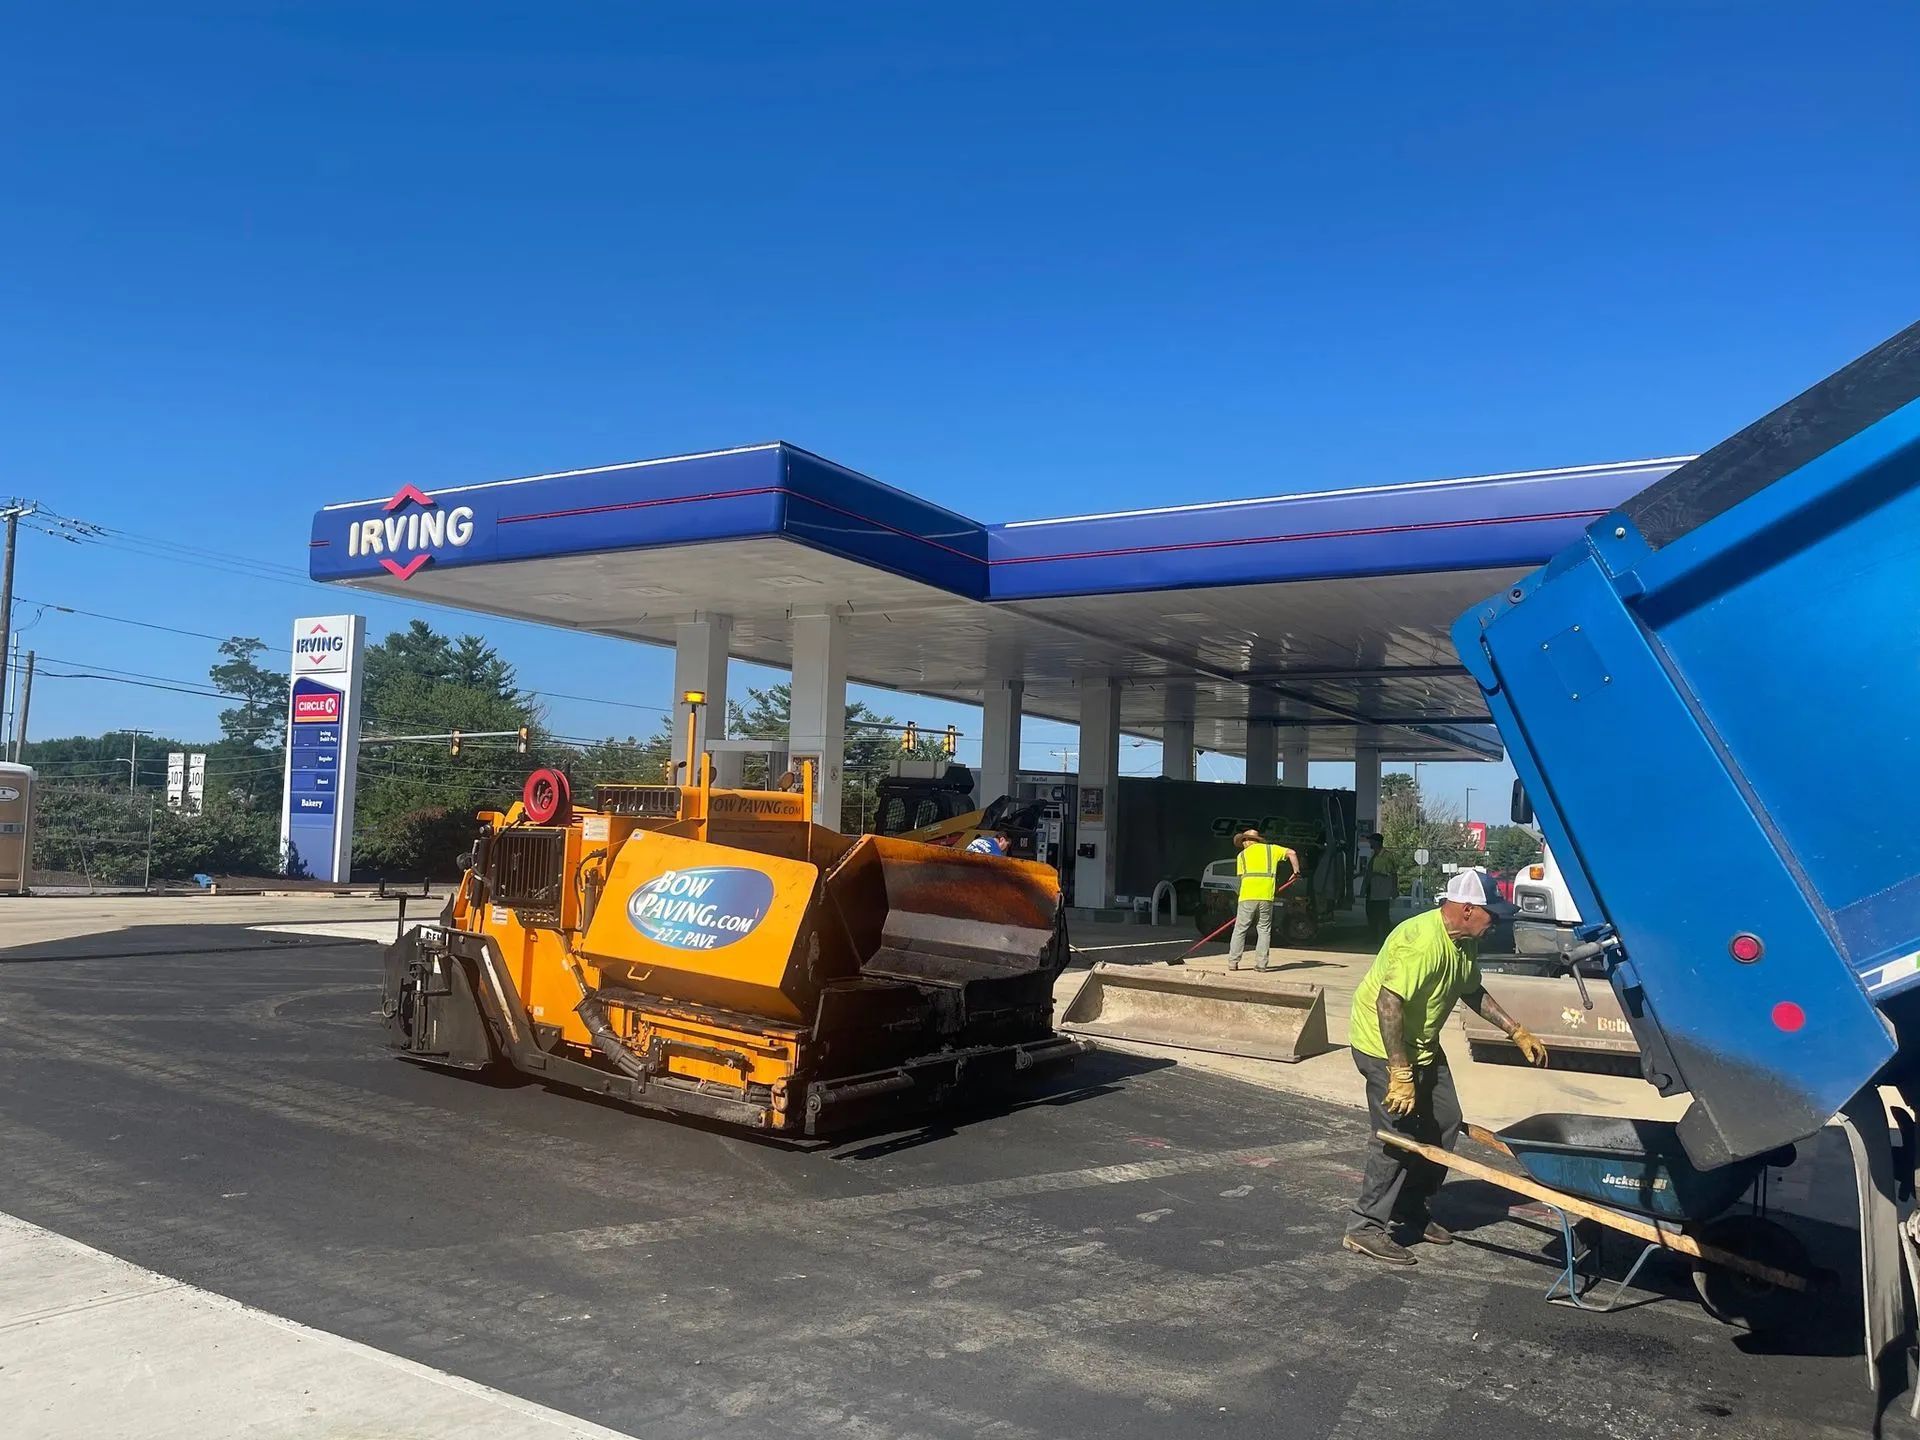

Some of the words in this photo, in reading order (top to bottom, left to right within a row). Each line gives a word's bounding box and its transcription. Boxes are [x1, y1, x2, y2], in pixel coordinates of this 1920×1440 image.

[349, 506, 474, 557] IRVING
[296, 636, 343, 654] IRVING
[298, 701, 324, 711] CIRCLE
[326, 698, 335, 712] K
[194, 756, 201, 764] TO
[171, 771, 182, 785] 107
[192, 772, 203, 786] 101
[301, 798, 323, 809] Bakery
[709, 798, 736, 812] OW
[655, 870, 714, 899] BOW
[635, 893, 755, 934] PAVING.COM
[655, 926, 718, 950] 227-PAVE
[1601, 1173, 1649, 1188] Jackson
